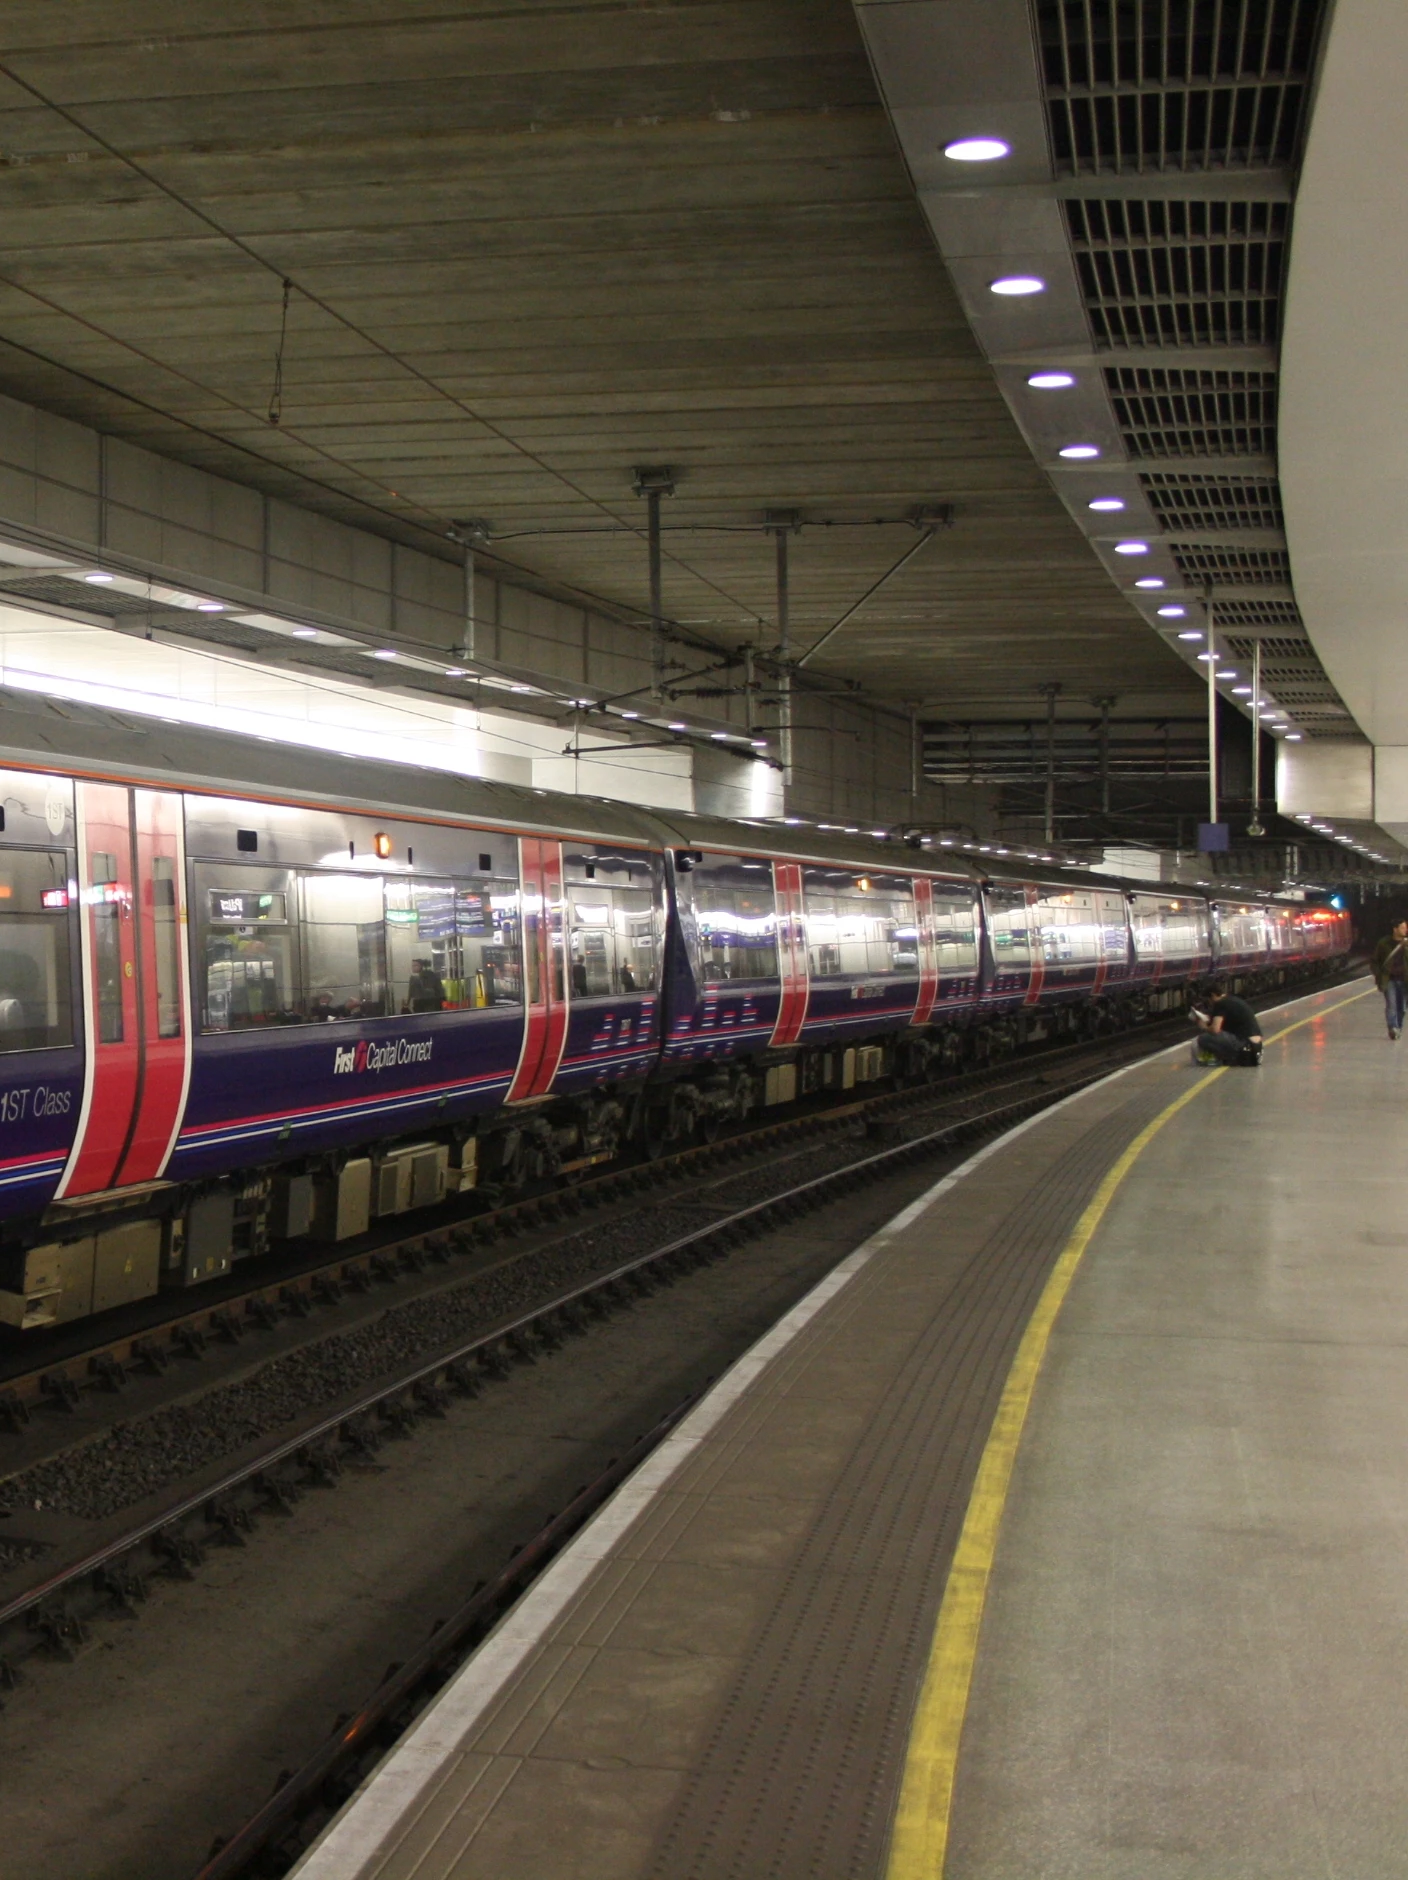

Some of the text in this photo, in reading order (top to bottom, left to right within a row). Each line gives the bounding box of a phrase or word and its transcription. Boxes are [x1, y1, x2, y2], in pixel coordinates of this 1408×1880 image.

[333, 1037, 433, 1074] First Capital Connect
[0, 1086, 71, 1122] 1ST Class
